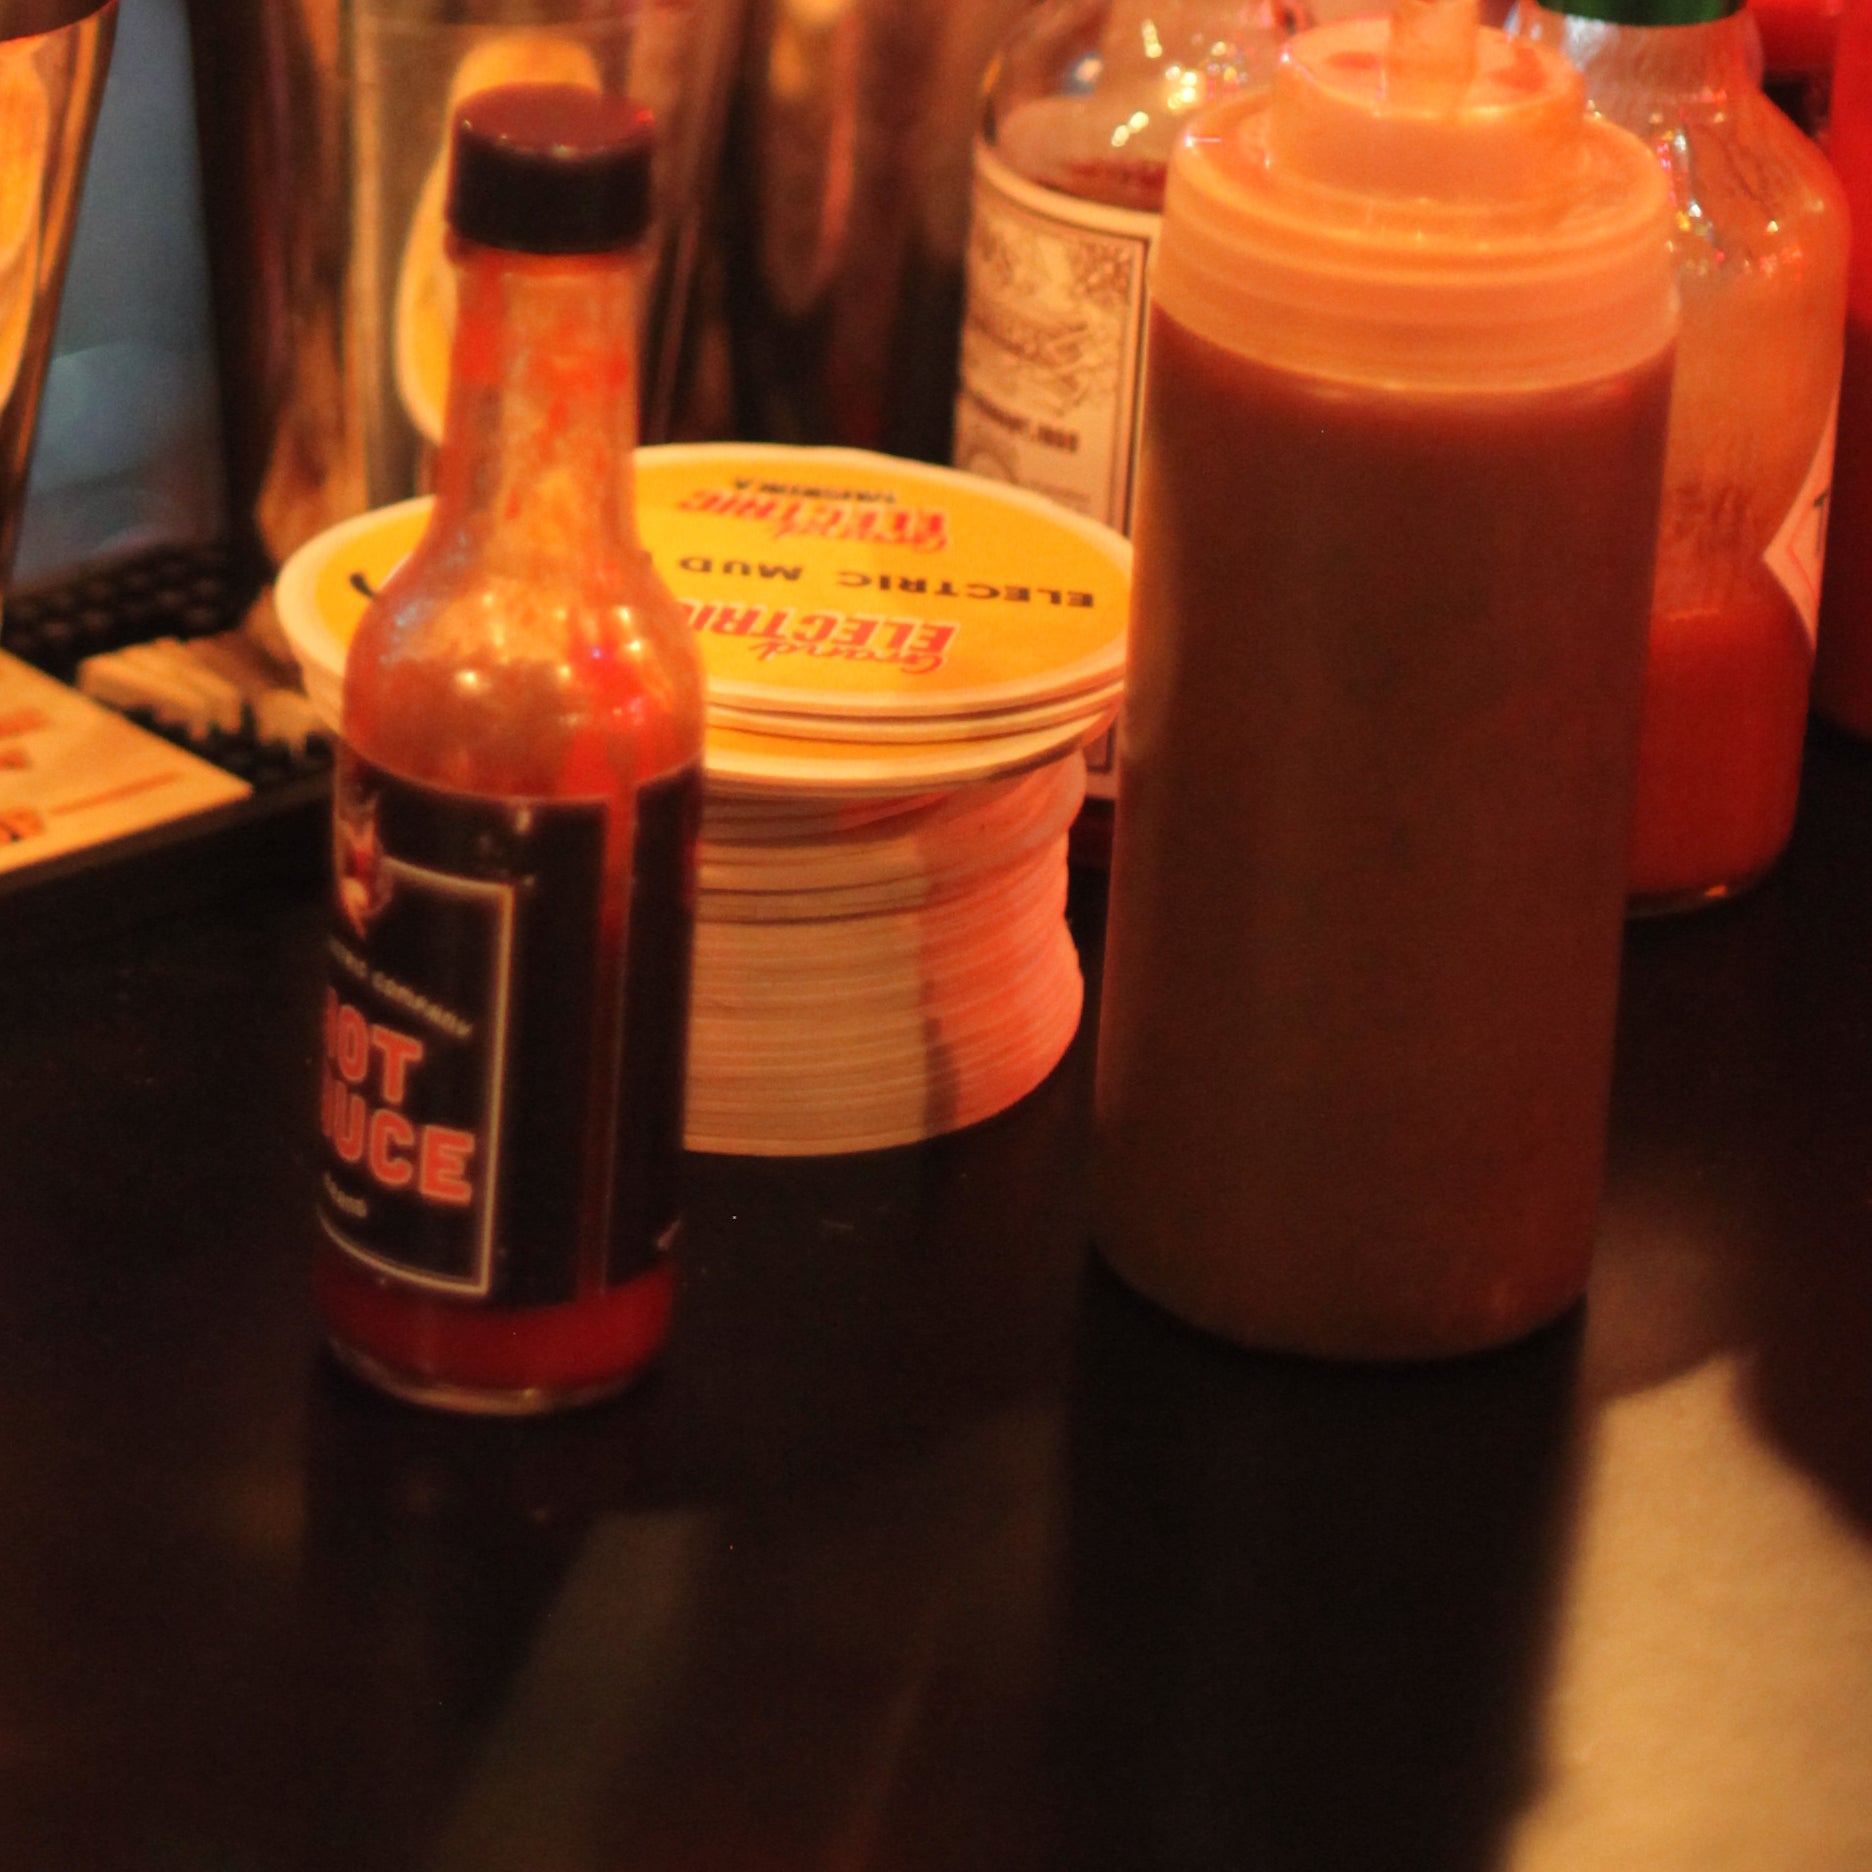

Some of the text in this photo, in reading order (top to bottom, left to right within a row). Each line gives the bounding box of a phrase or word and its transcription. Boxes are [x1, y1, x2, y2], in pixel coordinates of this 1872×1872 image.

[679, 556, 1095, 608] ELECTRIC MUD
[681, 599, 958, 654] ELECTRI
[752, 635, 945, 674] Grand
